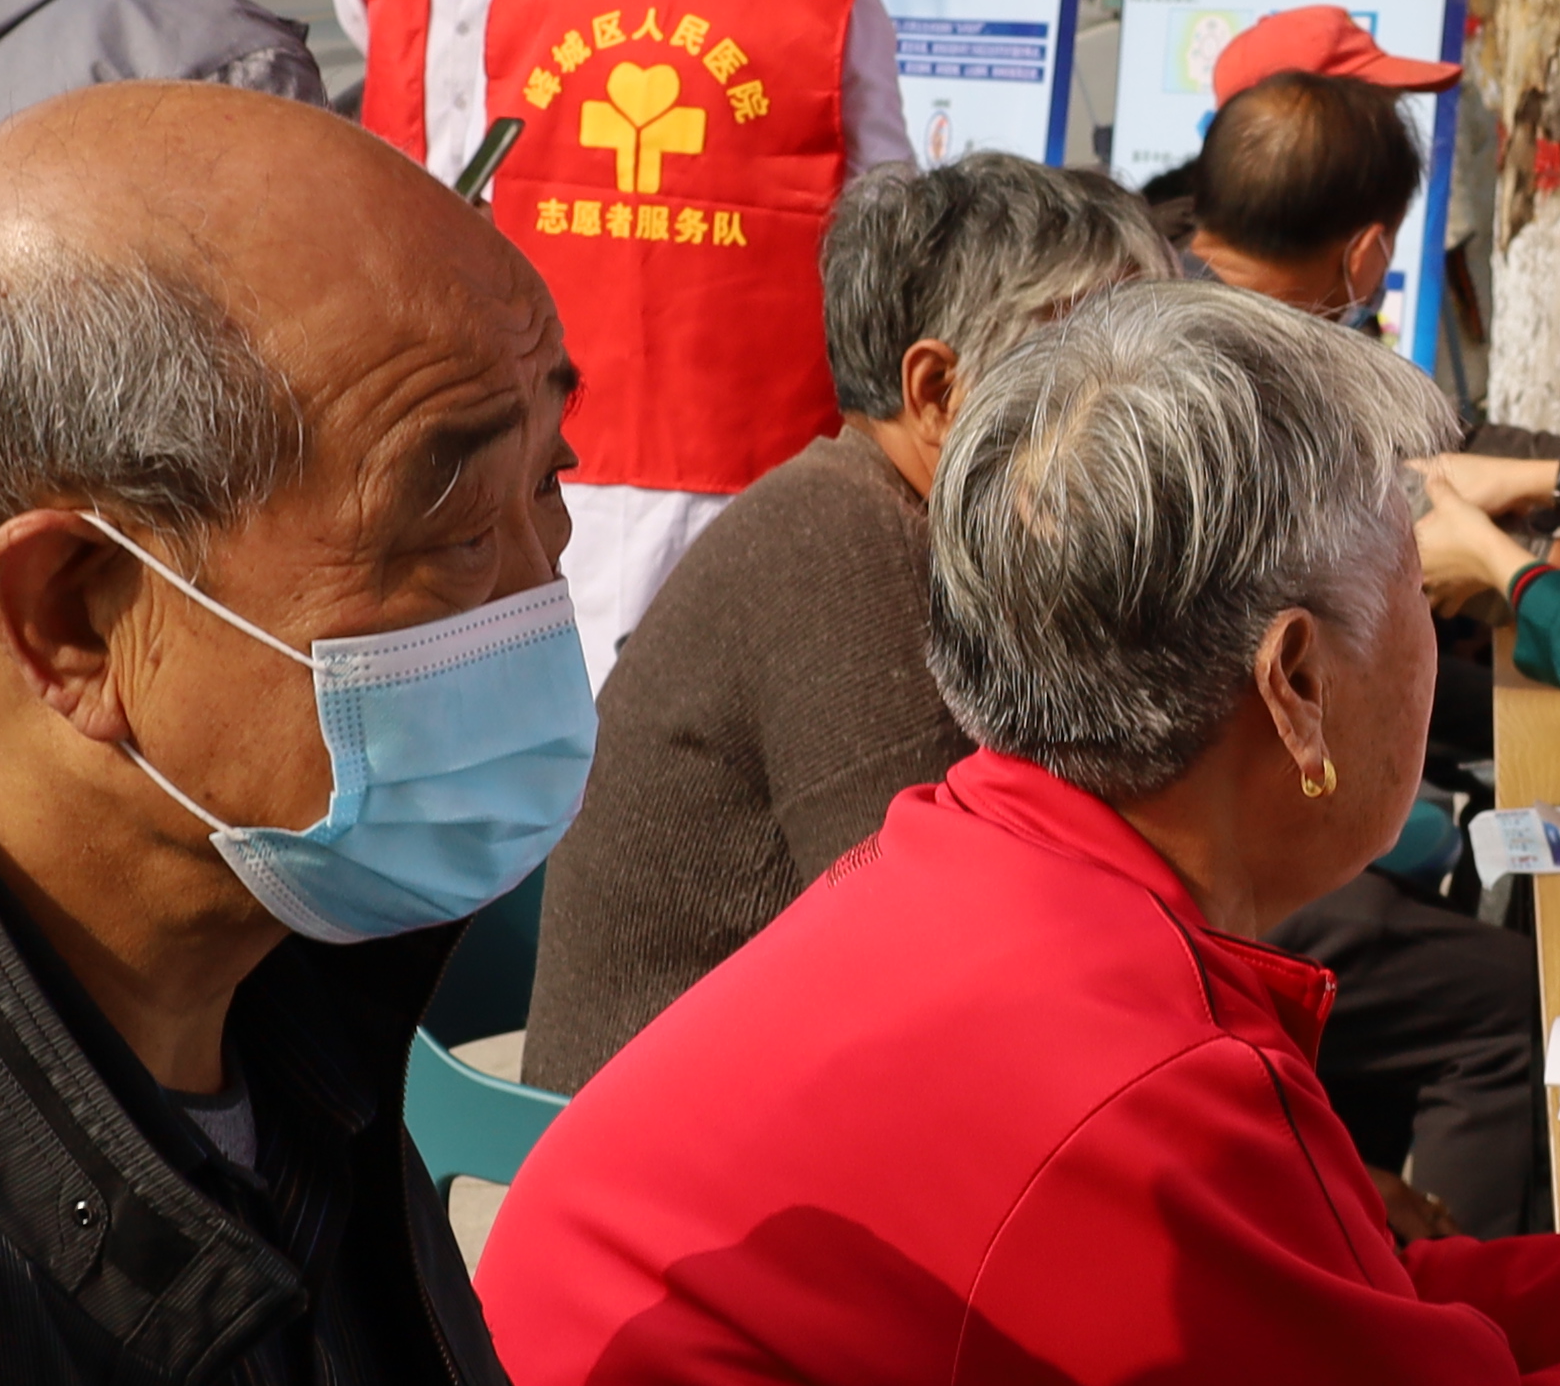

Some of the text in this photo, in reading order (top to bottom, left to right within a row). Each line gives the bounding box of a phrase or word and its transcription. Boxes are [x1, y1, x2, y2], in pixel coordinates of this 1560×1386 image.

[522, 7, 772, 125] 峄城区人民医院
[537, 197, 748, 247] 志愿者服务队
